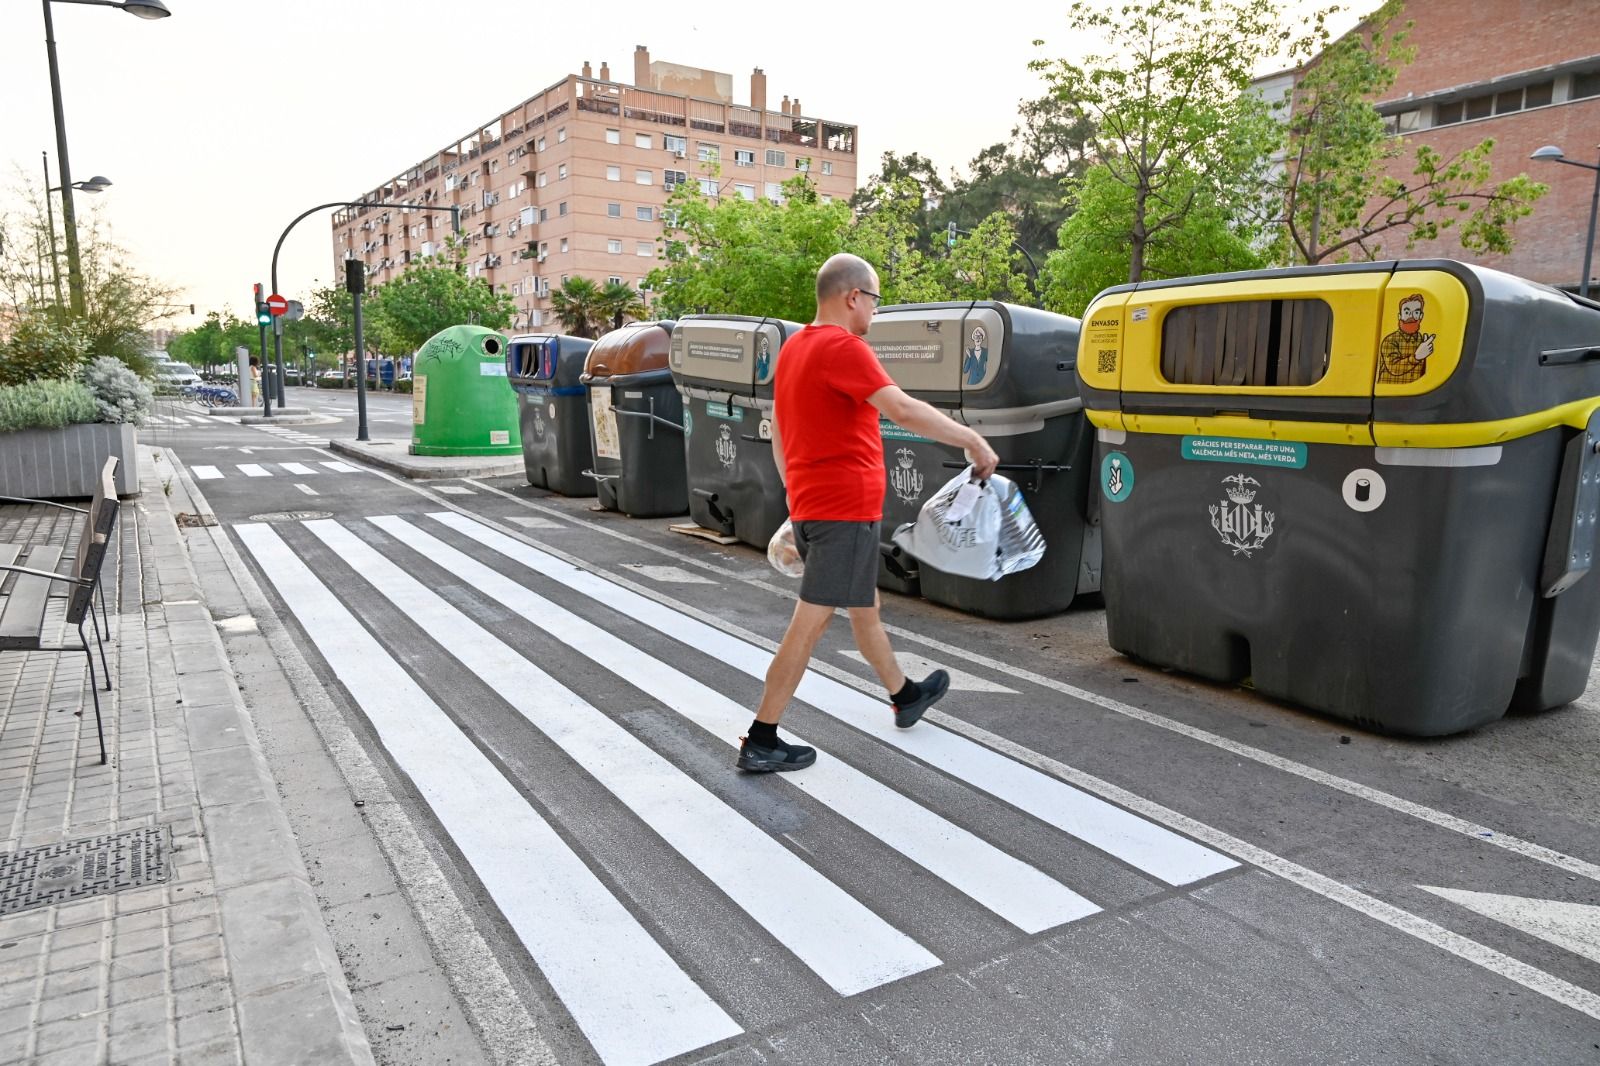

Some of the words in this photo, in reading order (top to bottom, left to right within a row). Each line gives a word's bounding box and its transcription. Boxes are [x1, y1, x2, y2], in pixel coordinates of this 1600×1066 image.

[1091, 319, 1119, 327] ENVASOS
[762, 425, 768, 436] R
[1192, 440, 1219, 448] GRÀCIES
[1220, 441, 1232, 449] PER
[1266, 444, 1278, 452] PER
[1279, 445, 1295, 453] UNA
[1223, 450, 1237, 458] MÉS
[1238, 452, 1257, 460] NETA,
[1258, 452, 1272, 460] MÉS
[1273, 454, 1296, 463] VERDA
